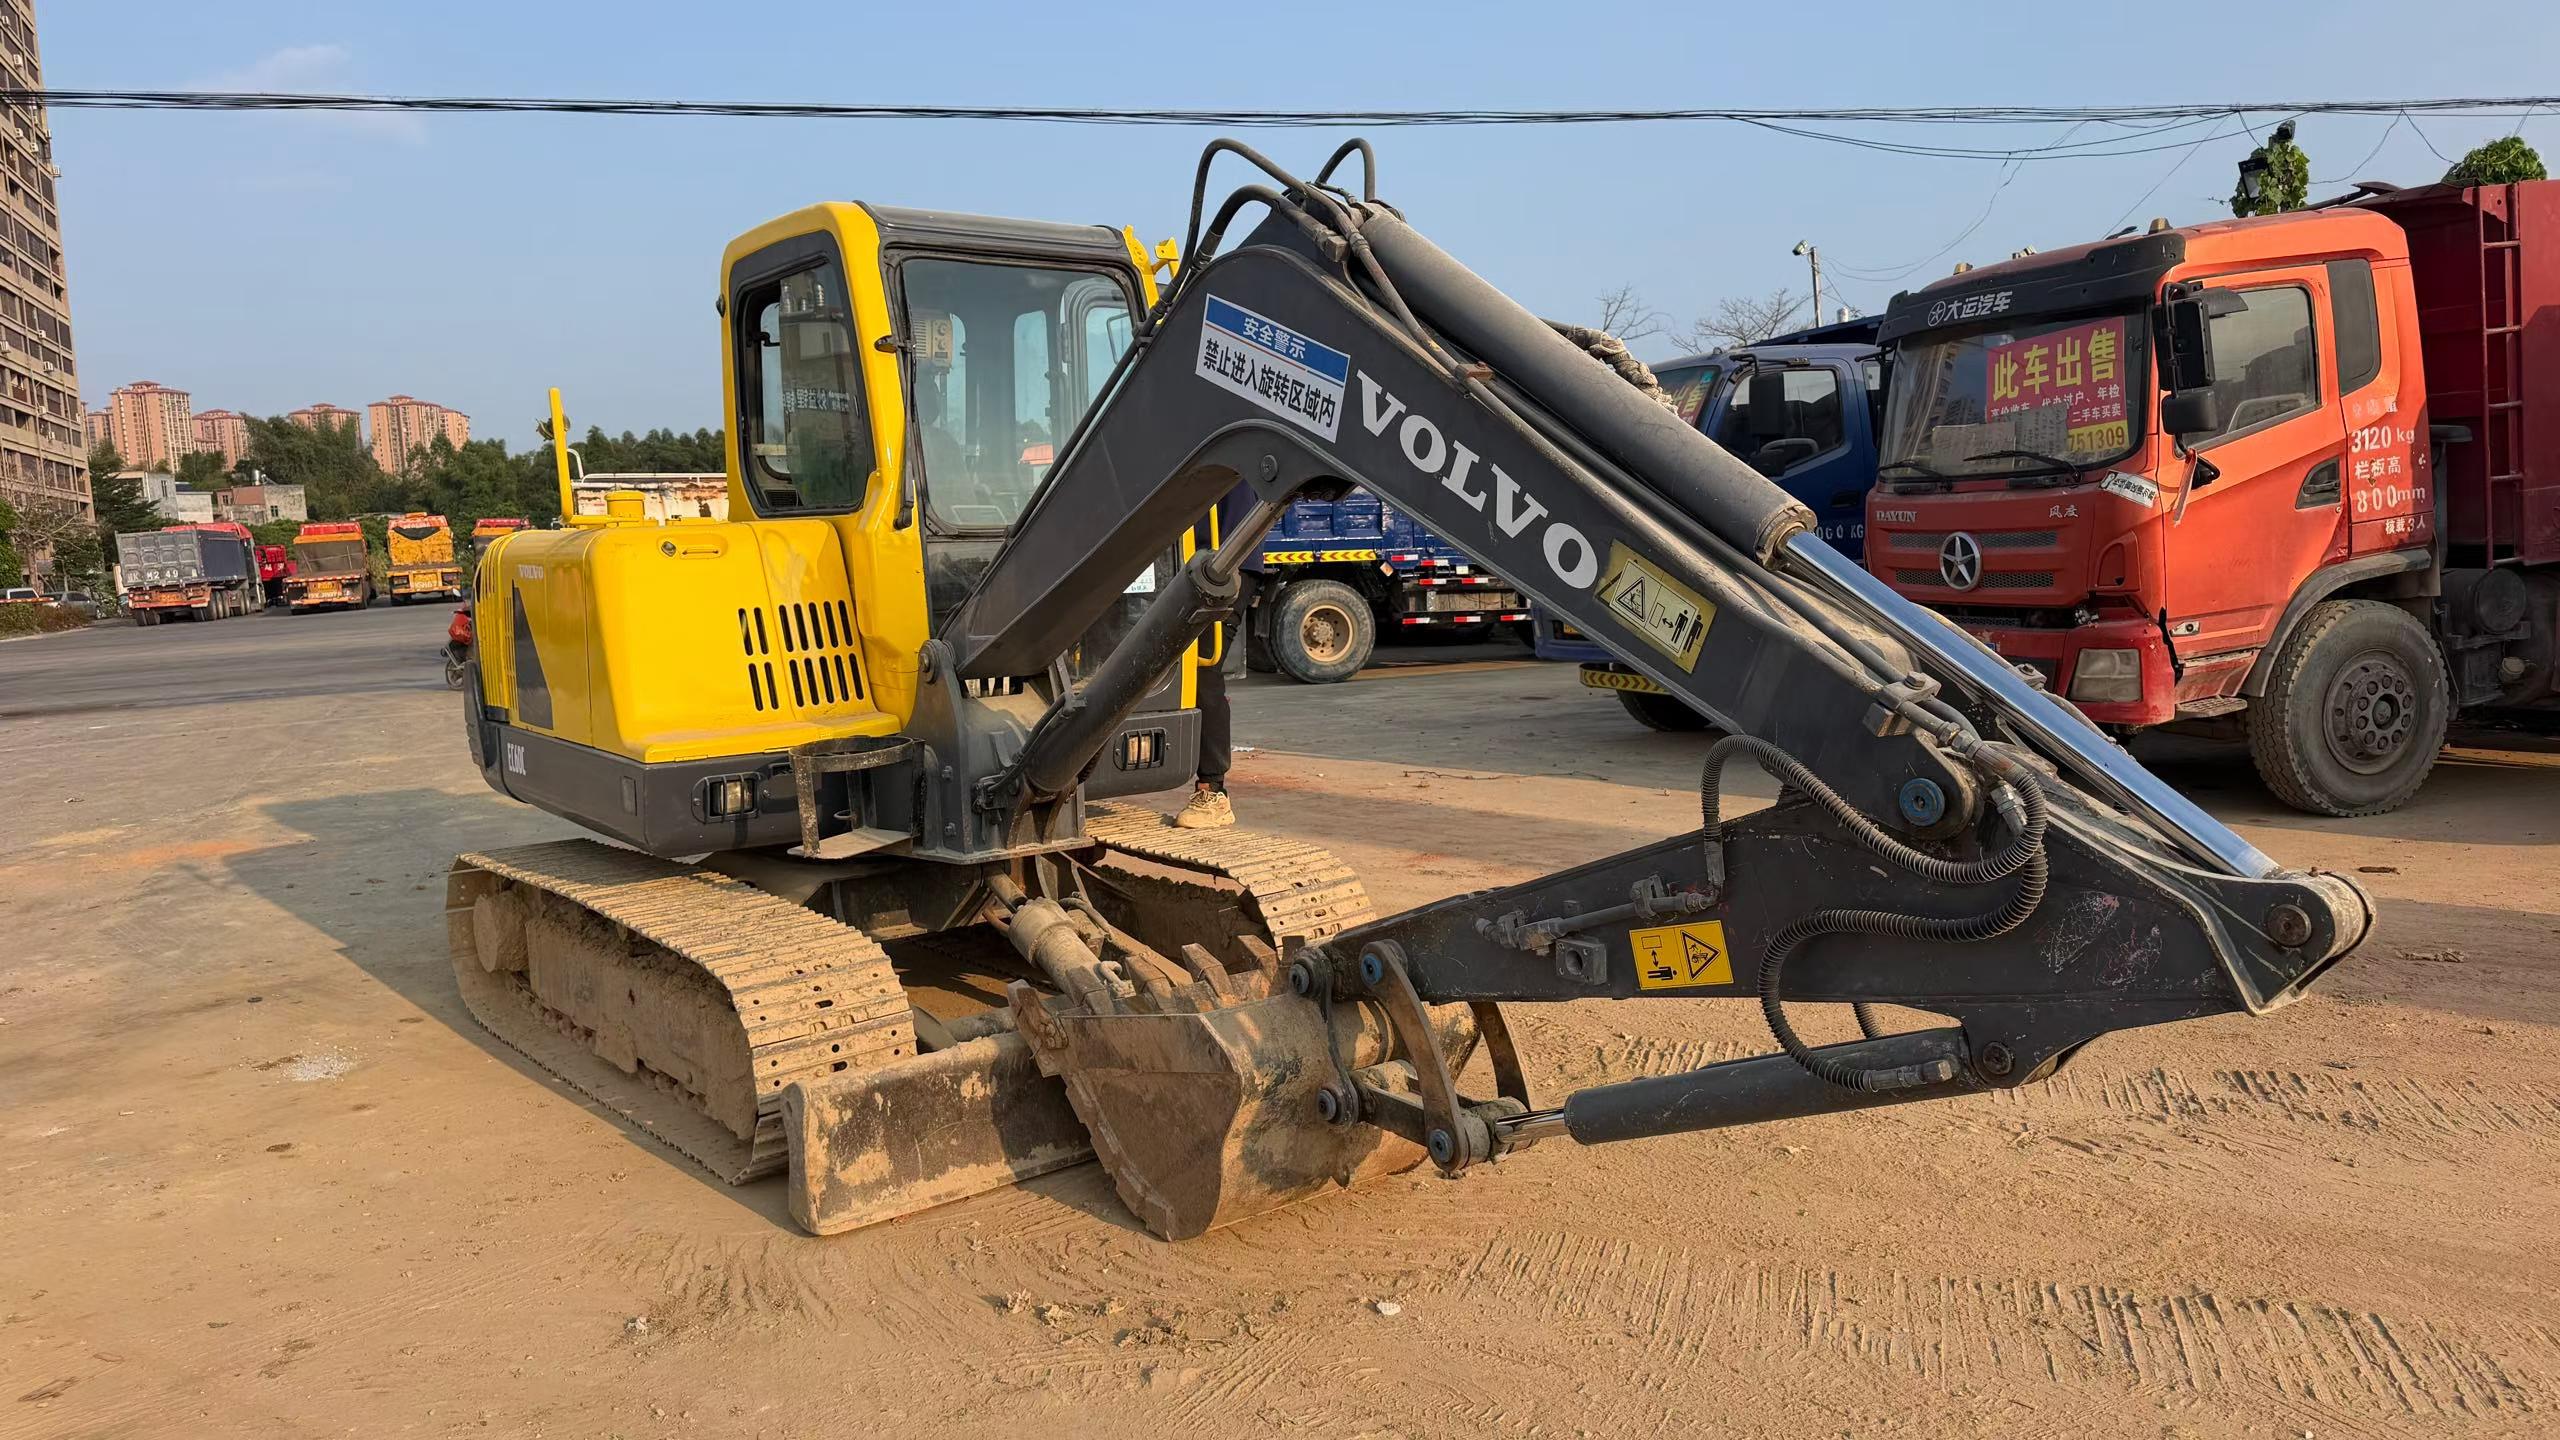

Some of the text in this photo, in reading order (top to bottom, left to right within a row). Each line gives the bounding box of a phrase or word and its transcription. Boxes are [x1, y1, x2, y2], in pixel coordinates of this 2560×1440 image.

[1944, 291, 2013, 321] 大运汽车
[1243, 317, 1306, 359] 安全警示
[1993, 328, 2116, 401] 此车出售
[1203, 338, 1336, 428] 禁止进入旋转区域内
[2072, 403, 2121, 423] 二手车买卖
[2351, 425, 2415, 453] 3120 kg
[1356, 369, 1598, 589] VOLVO
[2355, 456, 2401, 479] 栏板高
[1876, 510, 1917, 523] DAYUN
[2048, 504, 2080, 518] 风度
[1850, 524, 1864, 539] KG
[518, 564, 544, 580] VOLVO
[507, 742, 527, 776] EC60C
